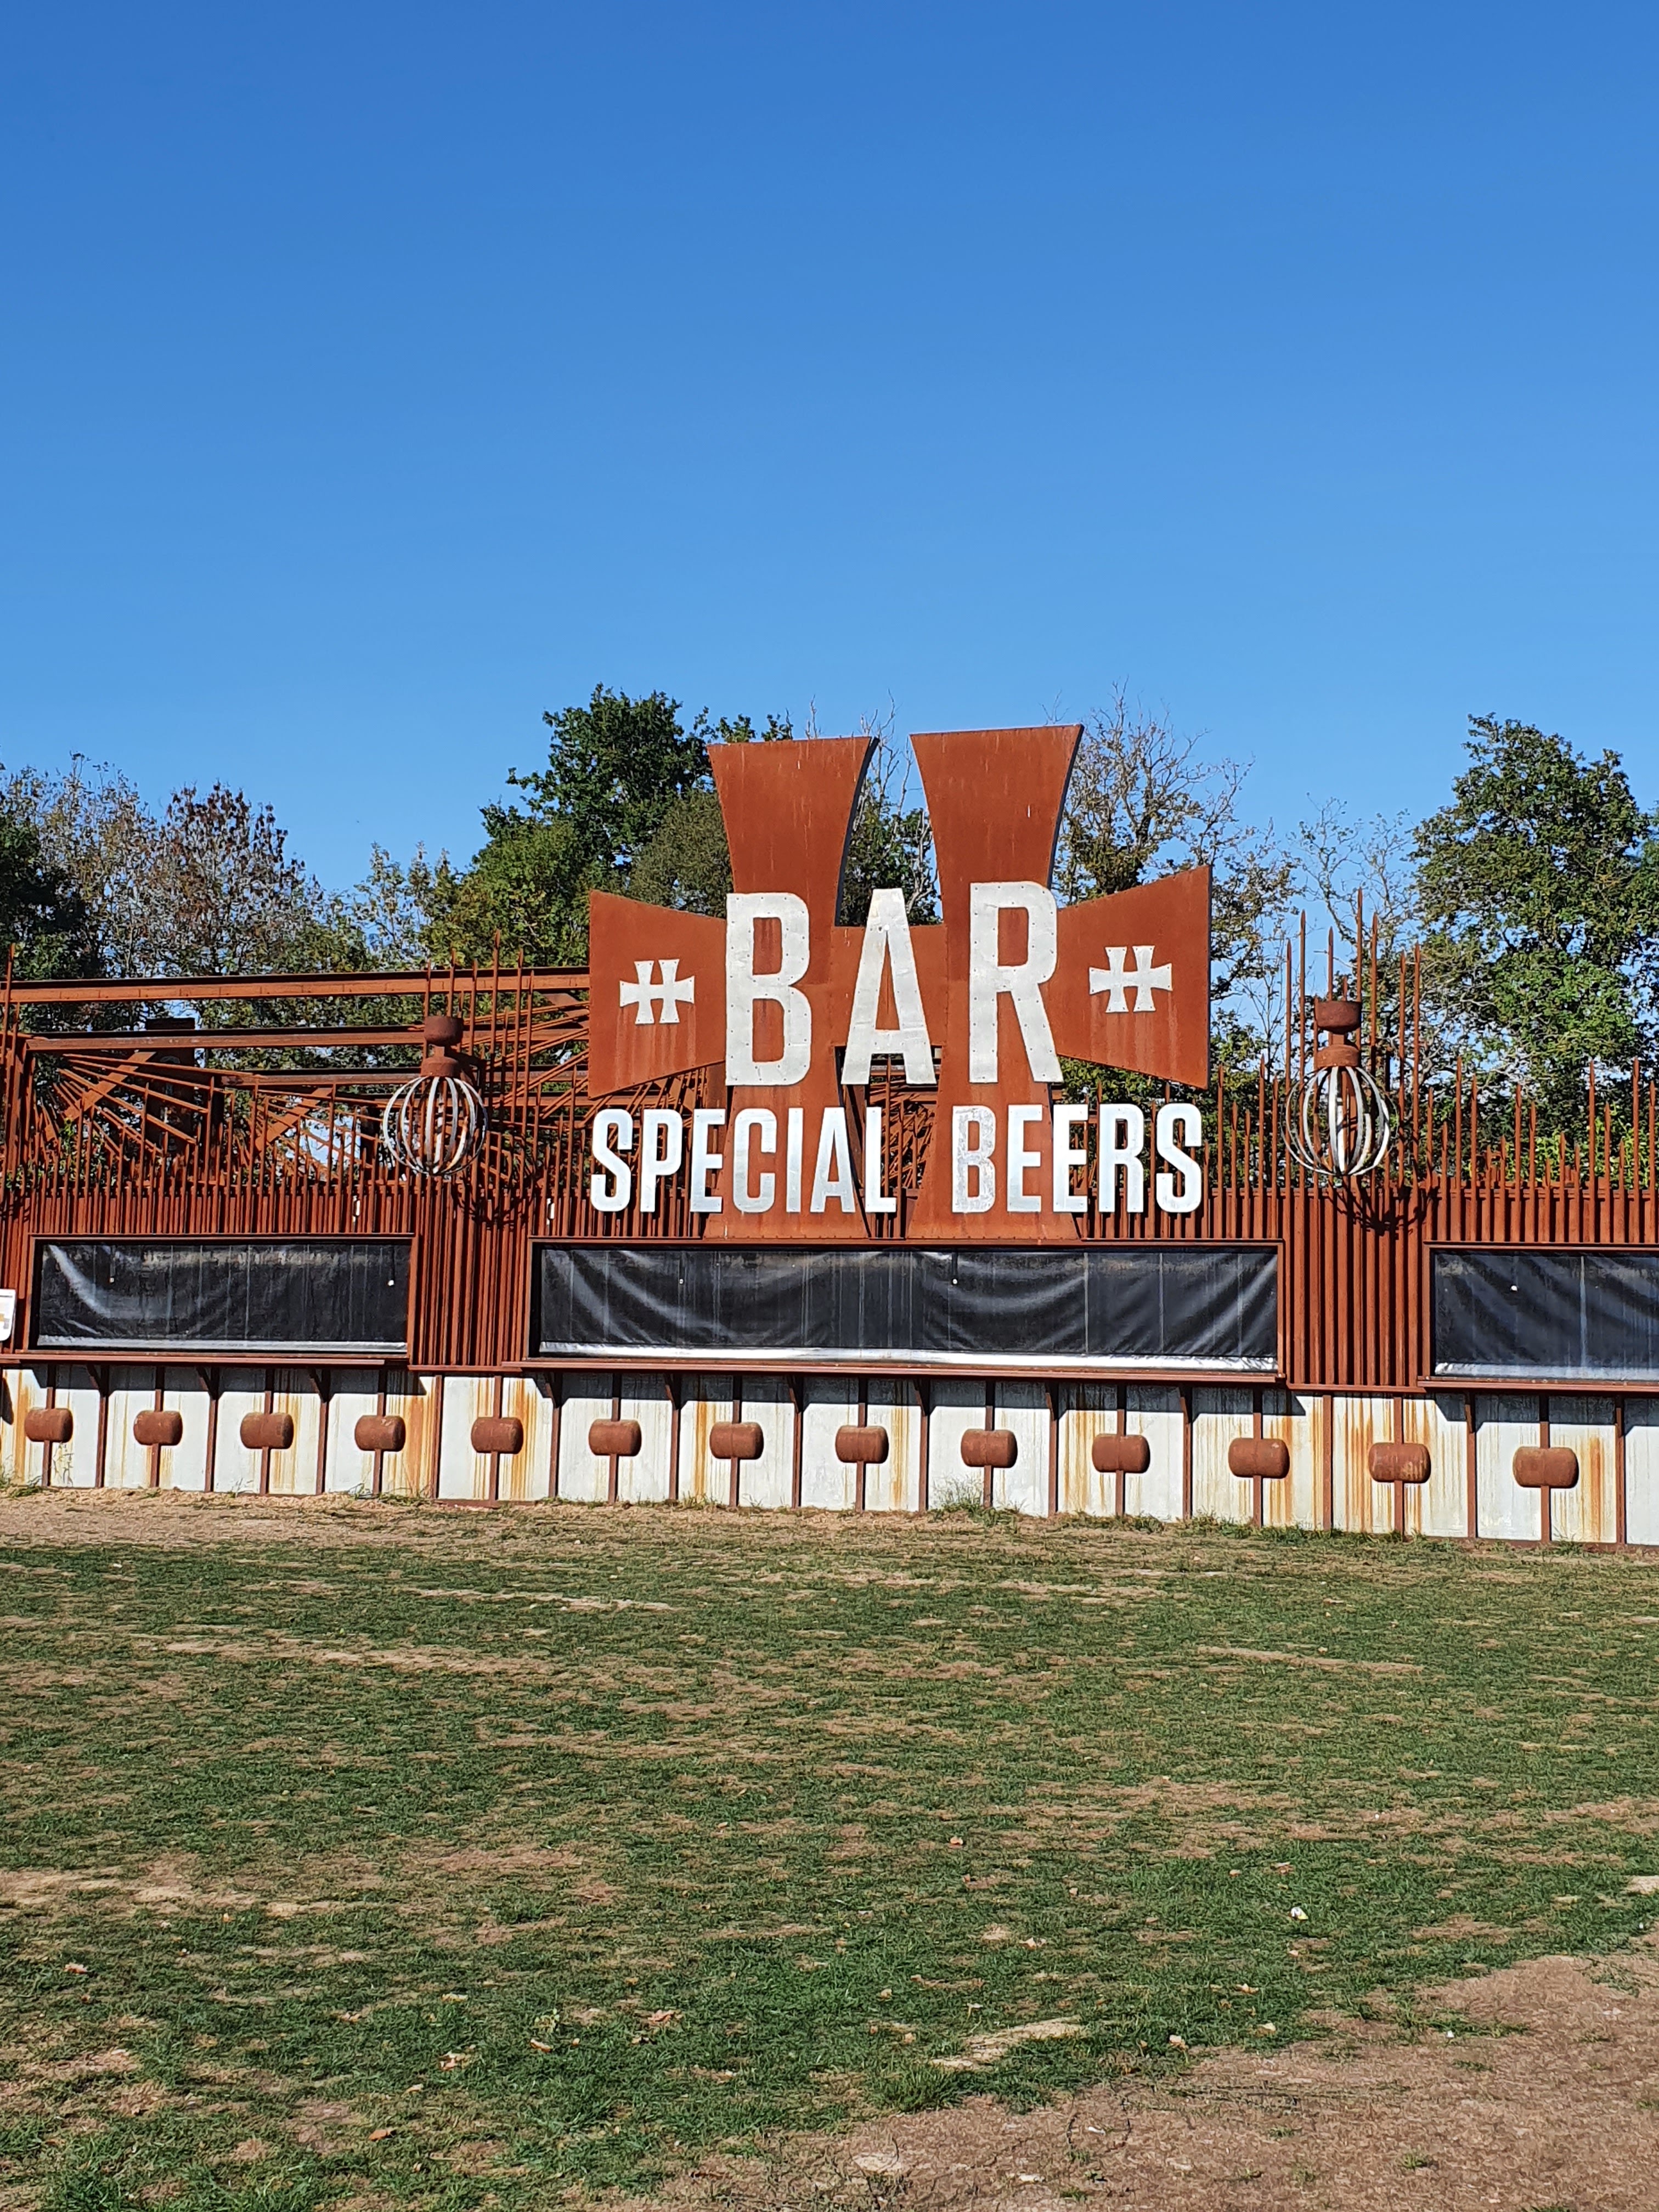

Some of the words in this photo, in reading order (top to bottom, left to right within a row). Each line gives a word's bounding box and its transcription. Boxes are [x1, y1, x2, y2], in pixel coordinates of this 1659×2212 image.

[725, 881, 1063, 1086] BAR
[590, 1107, 897, 1213] SPECIAL
[952, 1103, 1203, 1214] BEERS
